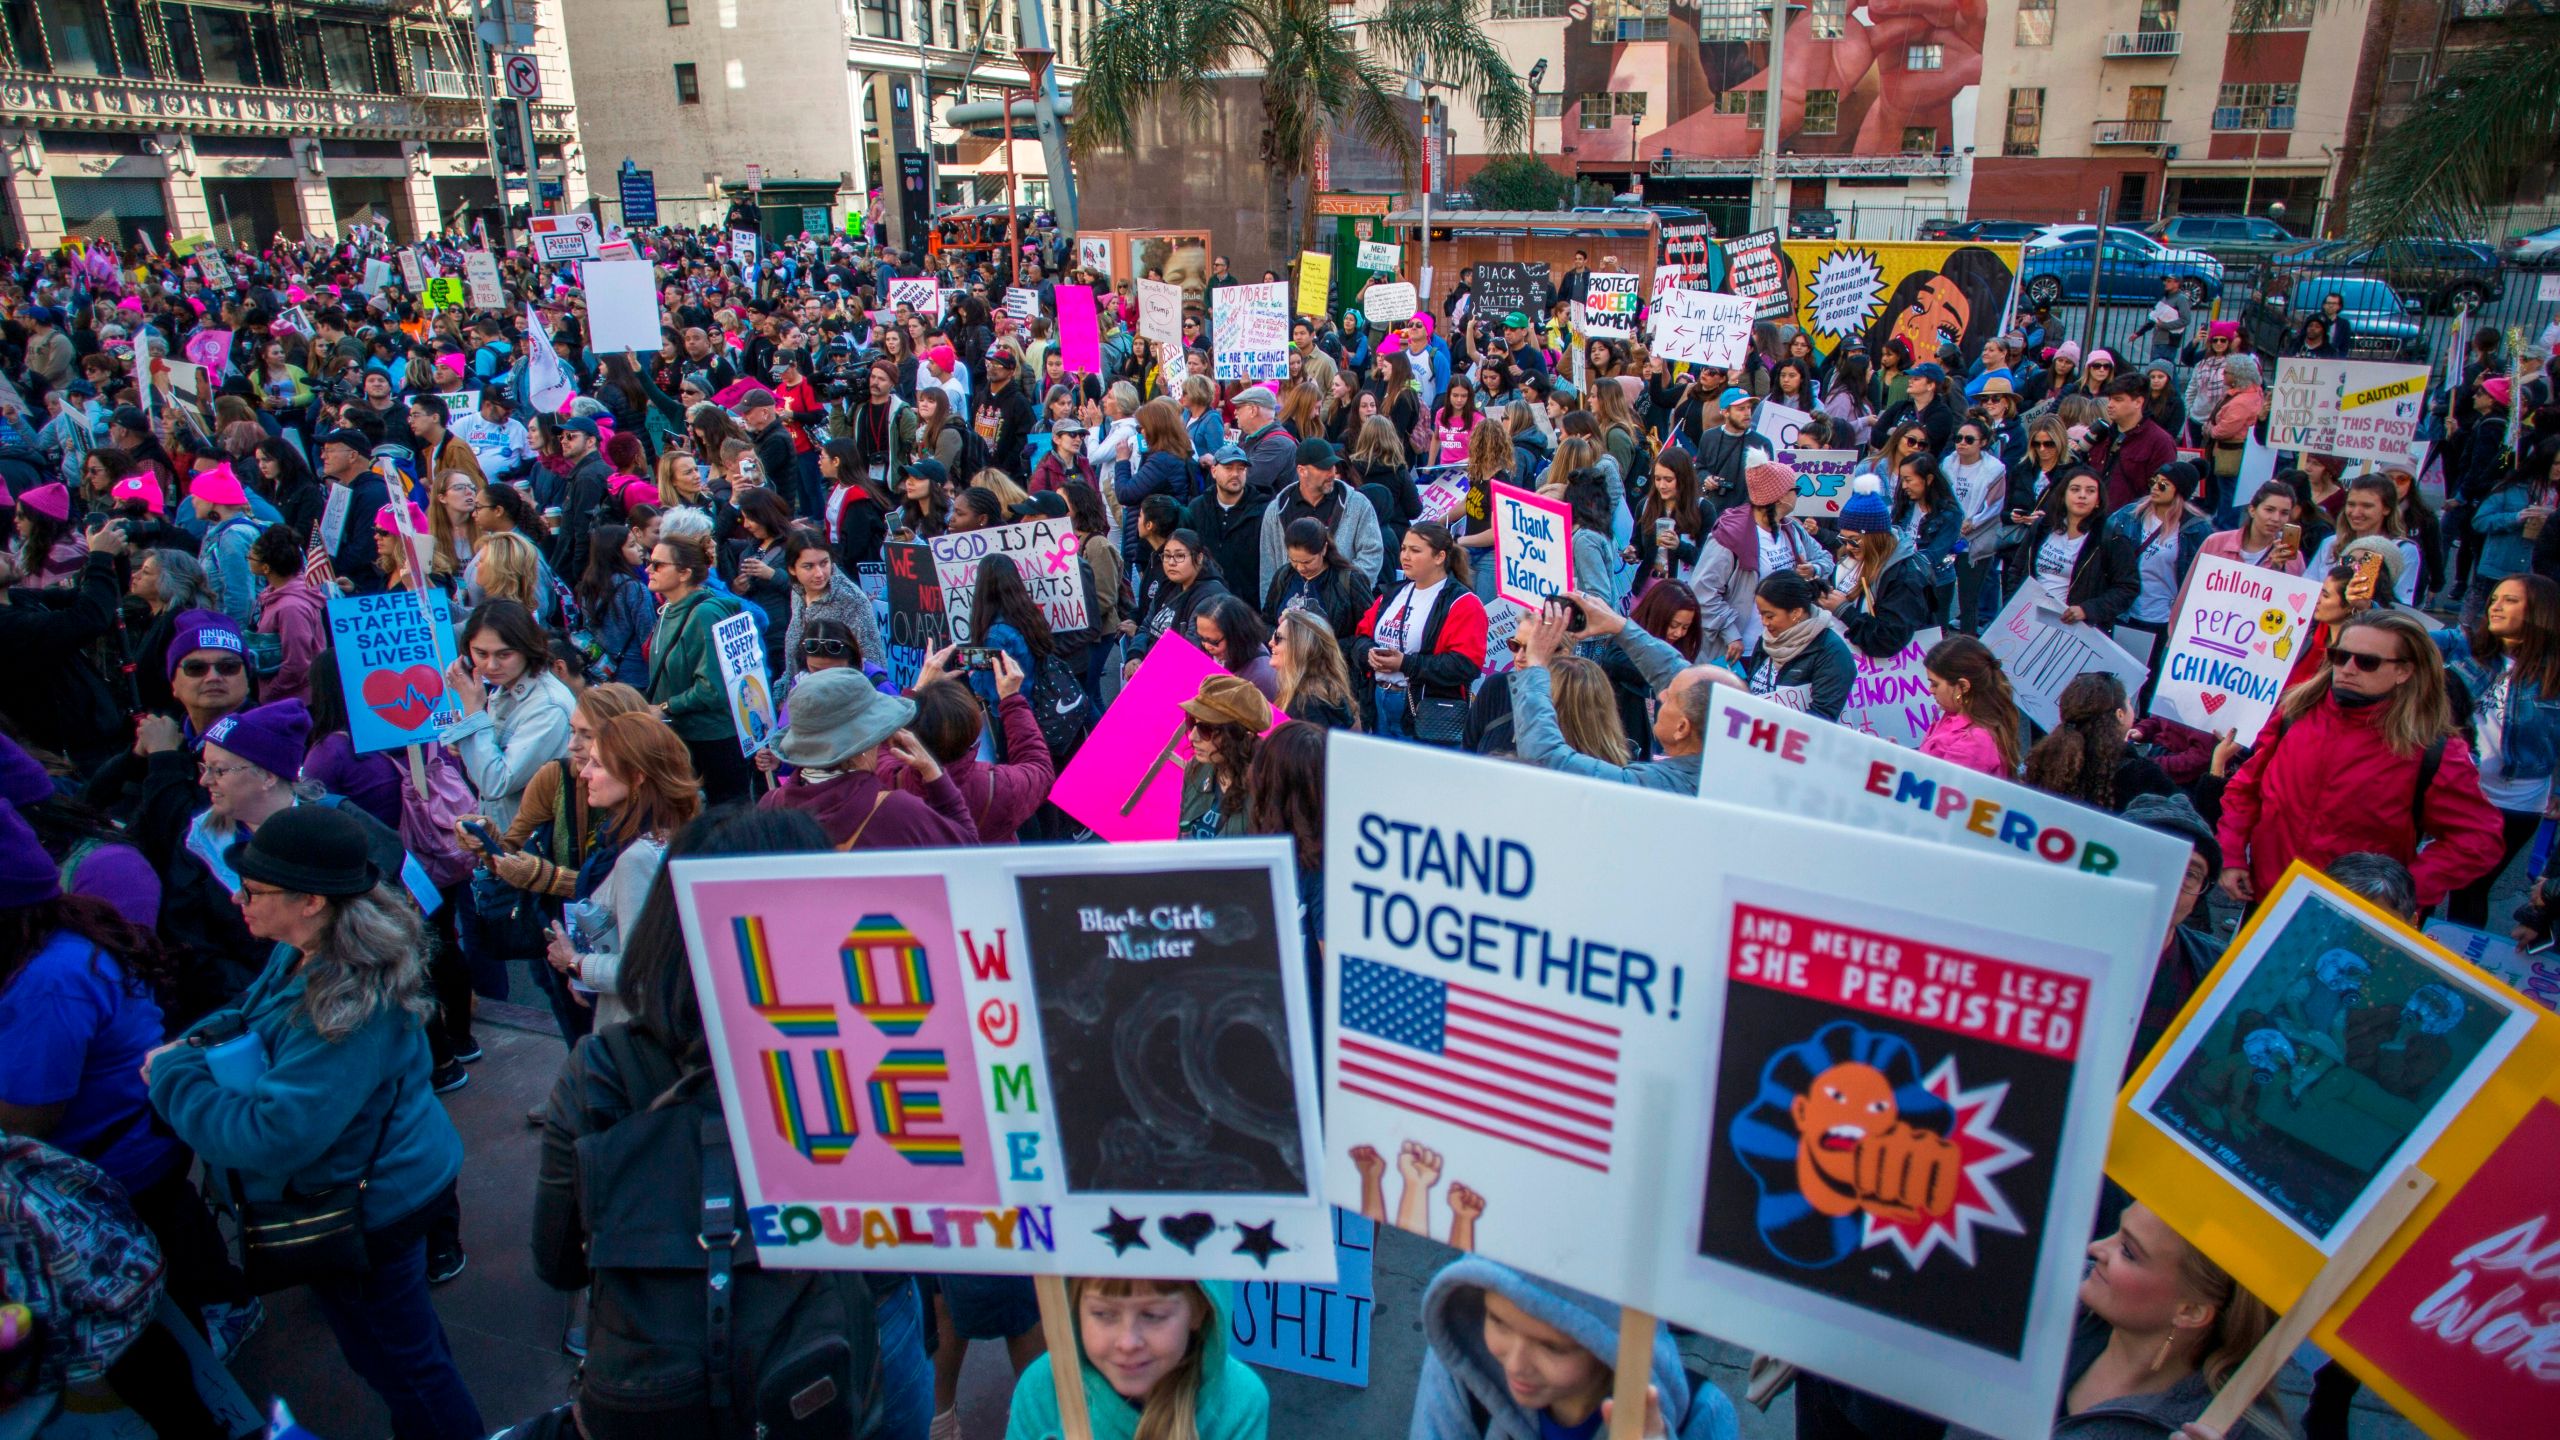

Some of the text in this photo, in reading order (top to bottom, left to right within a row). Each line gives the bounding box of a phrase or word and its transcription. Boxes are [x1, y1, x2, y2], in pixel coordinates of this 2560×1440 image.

[897, 88, 908, 107] M
[904, 157, 922, 167] Pershing
[905, 166, 919, 174] Square
[1318, 201, 1389, 215] ATM
[1355, 222, 1372, 233] ATM
[1662, 224, 1707, 238] CHILDHOOD
[1371, 244, 1387, 254] MEN
[1666, 241, 1705, 254] VACCINES
[1725, 231, 1776, 255] VACCINES
[1360, 260, 1369, 269] DO
[1363, 252, 1390, 263] WE MUST
[1733, 248, 1773, 269] KNOWN
[1733, 262, 1778, 284] TO CAUSE
[891, 281, 909, 300] MAKE
[900, 283, 920, 302] TRUTH
[911, 286, 927, 304] REAT
[1221, 284, 1273, 304] NO MORE!
[1589, 277, 1639, 293] PROTECT
[1689, 280, 1709, 290] 2019
[1734, 277, 1782, 298] SEIZURES
[915, 289, 935, 310] AGAIN
[1184, 292, 1201, 300] Rule
[1479, 295, 1525, 307] MATTER
[1587, 293, 1637, 312] QUEER
[1820, 292, 1863, 310] OFF OF OUR
[1150, 301, 1169, 317] Trump
[1682, 301, 1742, 325] I'm With
[1825, 305, 1859, 320] BODIES!
[1585, 312, 1637, 331] WOMEN
[1699, 325, 1726, 344] HER
[1218, 351, 1285, 362] WE ARE THE CHANGE
[1216, 364, 1231, 378] VOTE
[1275, 364, 1287, 378] WHO
[2282, 366, 2325, 385] ALL
[2278, 386, 2316, 409] YOU
[2357, 382, 2410, 406] CAUTION
[2274, 410, 2314, 427] NEED
[2342, 416, 2416, 437] THIS PUSSY
[2269, 427, 2317, 447] LOVE
[2336, 433, 2375, 450] GRABS
[2379, 438, 2408, 454] BACK
[1796, 474, 1846, 497] AF
[1506, 500, 1554, 543] Thank
[933, 521, 1056, 562] GOD IS A
[1517, 536, 1546, 563] You
[889, 547, 918, 580] WE
[941, 555, 1043, 588] WOAN
[1506, 556, 1560, 598] Nancy
[2205, 569, 2273, 603] chillona
[359, 592, 419, 613] SAFE
[918, 584, 944, 612] NOT
[356, 626, 433, 650] SAVES
[719, 615, 751, 643] PATIENT
[1379, 625, 1409, 641] MARH
[362, 643, 435, 667] LIVES!
[724, 632, 753, 661] SAFETY
[1888, 640, 1927, 672] WE
[731, 658, 742, 677] IS
[895, 665, 916, 689] MY
[2170, 652, 2279, 705] CHINGONA
[1723, 705, 1812, 766] THE
[1865, 759, 2120, 877] EMPEROR
[1355, 812, 1536, 900] STAND
[1077, 903, 1216, 932] Black Girls
[1105, 932, 1195, 962] Matter
[1352, 882, 1684, 1021] TOGETHER!
[1740, 913, 2082, 1011] AND NEVER THE LESS
[1735, 944, 2074, 1053] SHE PERSISTED
[2215, 1144, 2241, 1166] YOU
[1231, 1280, 1372, 1369] SHIT
